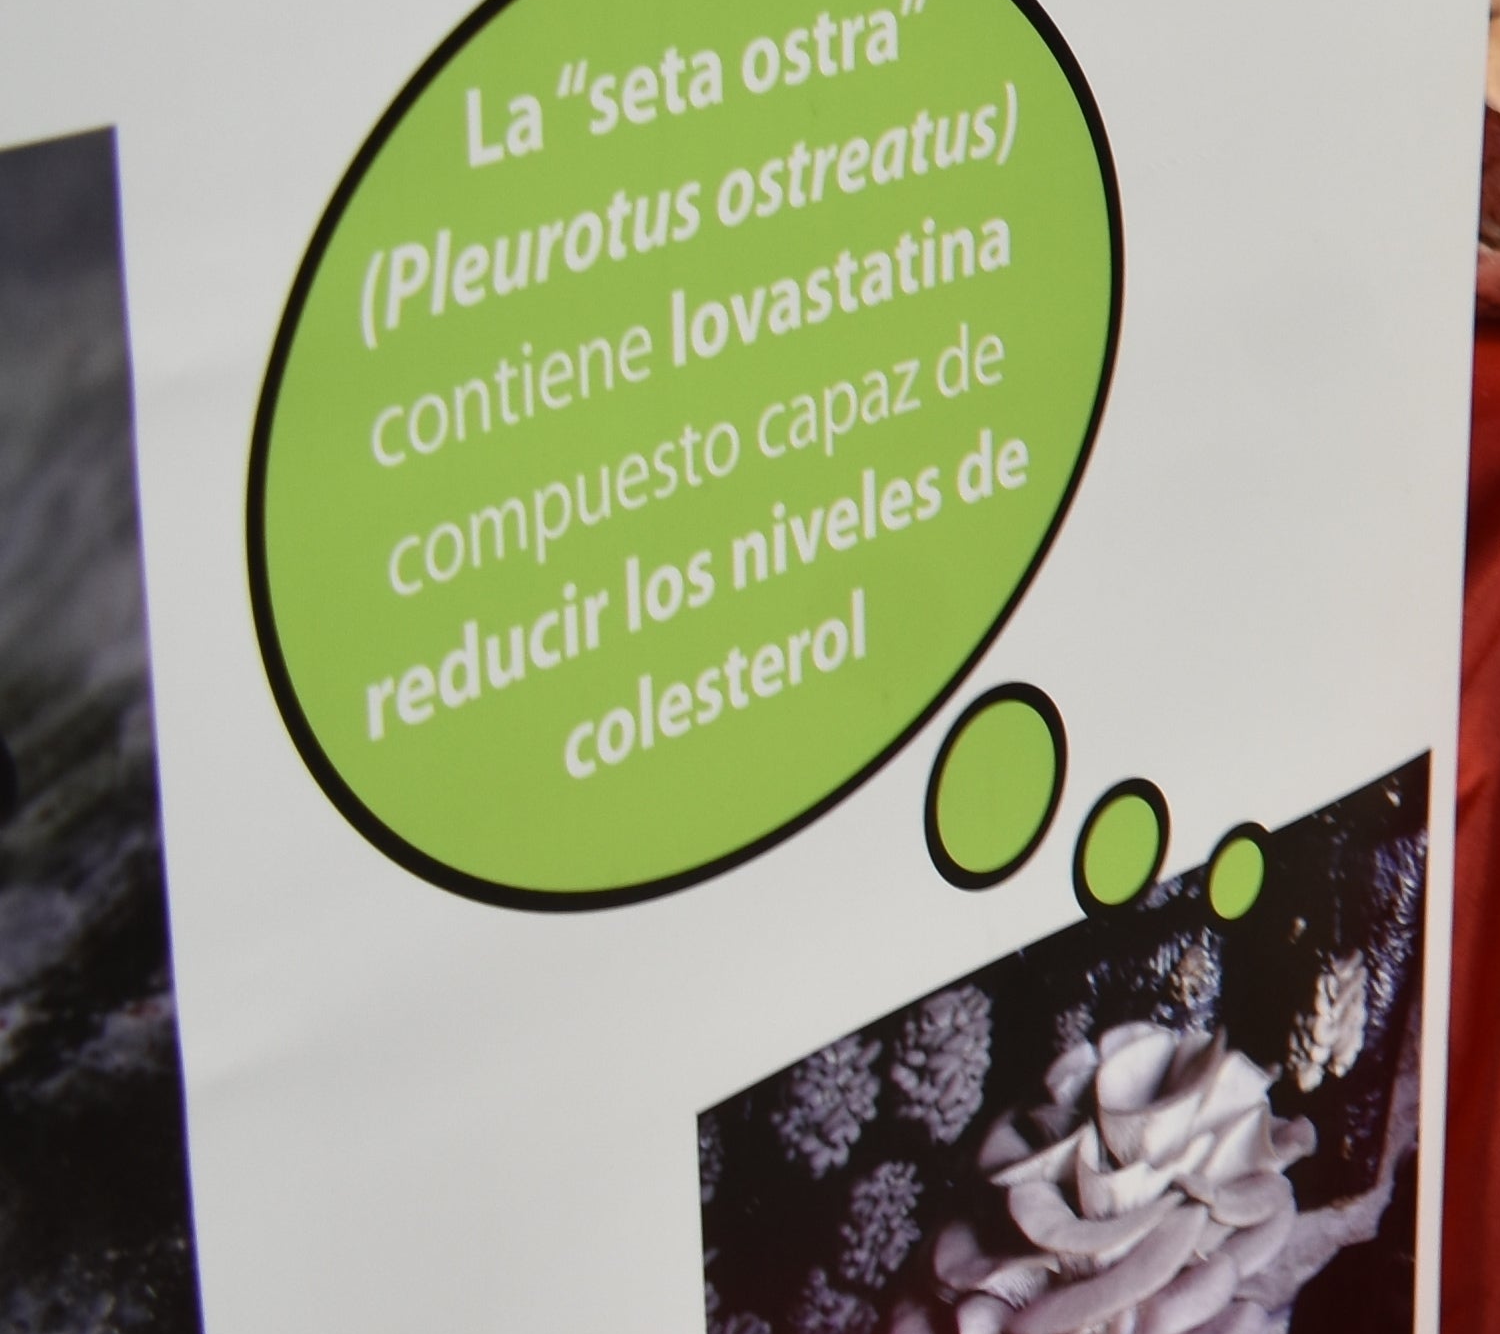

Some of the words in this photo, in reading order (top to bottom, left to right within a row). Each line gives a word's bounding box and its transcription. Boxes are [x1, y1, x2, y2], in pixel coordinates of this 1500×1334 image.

[359, 181, 700, 349] (Pleurotus
[716, 80, 1018, 227] ostreatus)
[464, 87, 544, 167] La
[557, 47, 723, 136] “seta
[370, 324, 654, 469] contiene
[670, 215, 1012, 367] lovastatina
[387, 421, 741, 598] compuesto
[757, 358, 921, 459] capaz
[936, 321, 1005, 403] de
[364, 583, 610, 742] reducir
[625, 549, 715, 634] los
[731, 466, 943, 591] niveles
[957, 427, 1030, 507] de
[563, 587, 868, 780] colesterol
